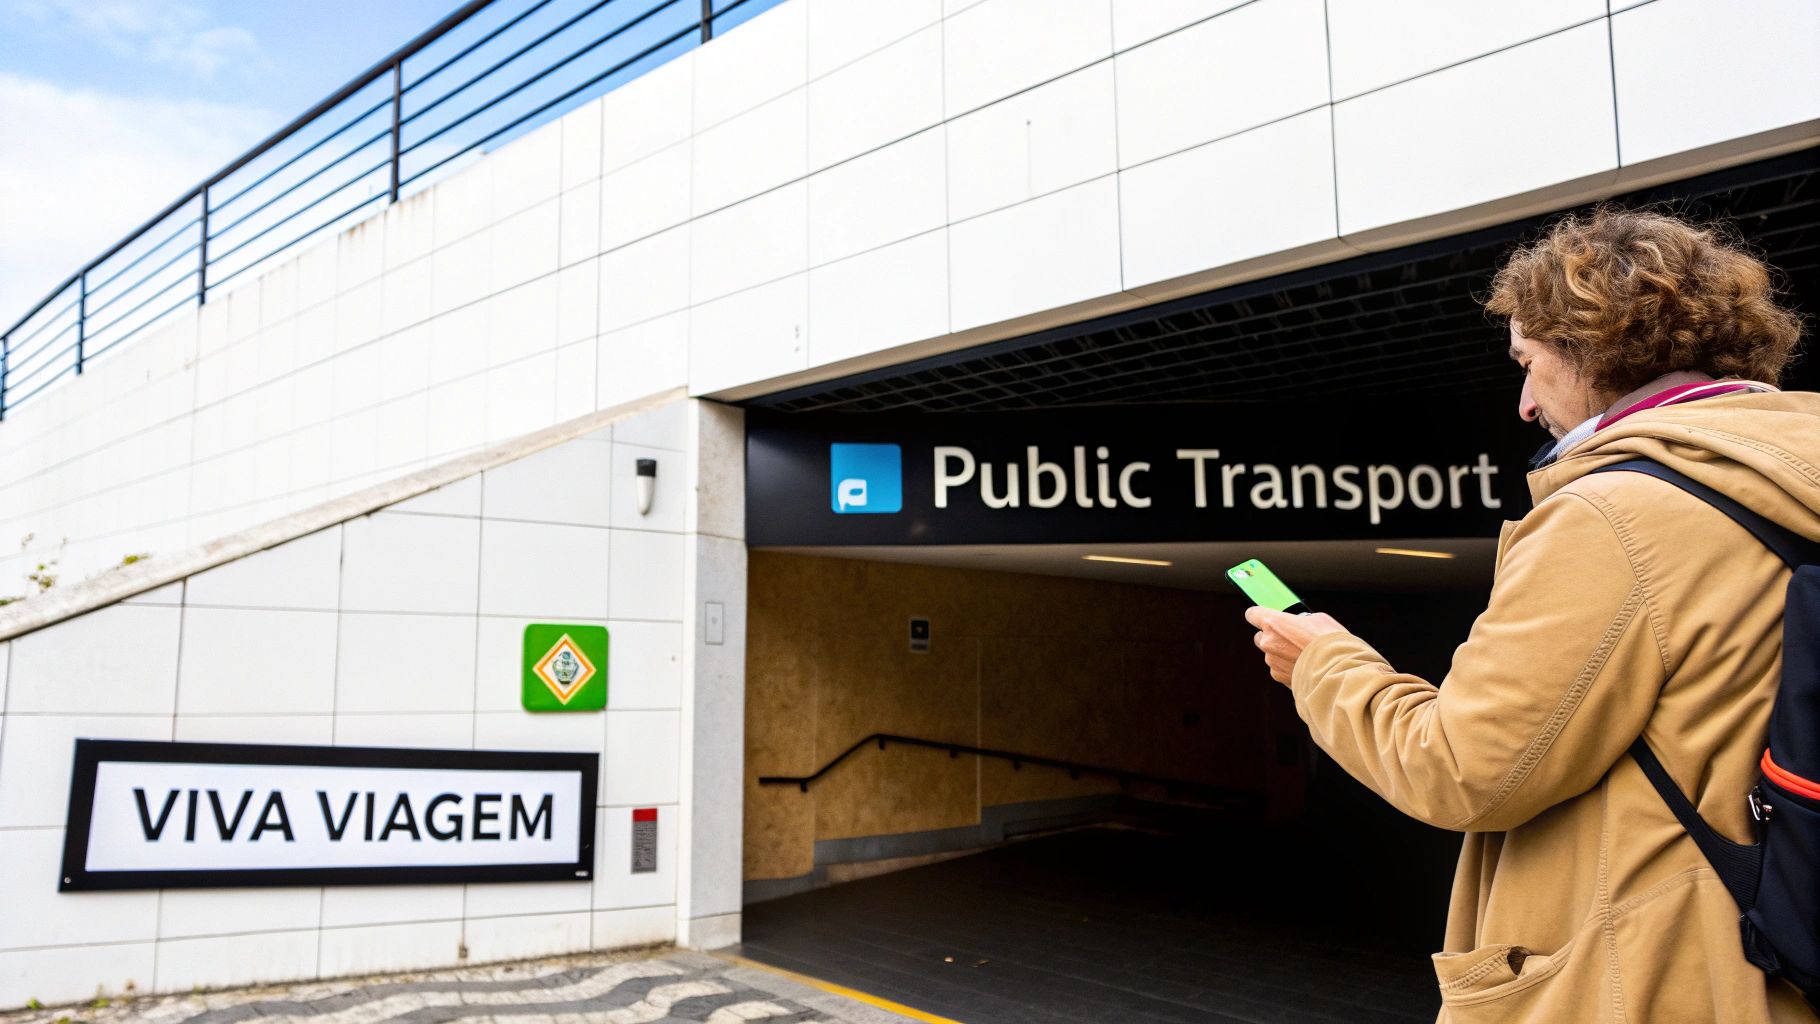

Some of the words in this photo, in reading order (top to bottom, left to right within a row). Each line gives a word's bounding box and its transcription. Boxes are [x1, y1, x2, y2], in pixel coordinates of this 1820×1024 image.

[935, 446, 1151, 508] Public
[1177, 450, 1500, 524] Transport
[134, 789, 294, 841] VIVA
[318, 792, 552, 841] VIAGEM
